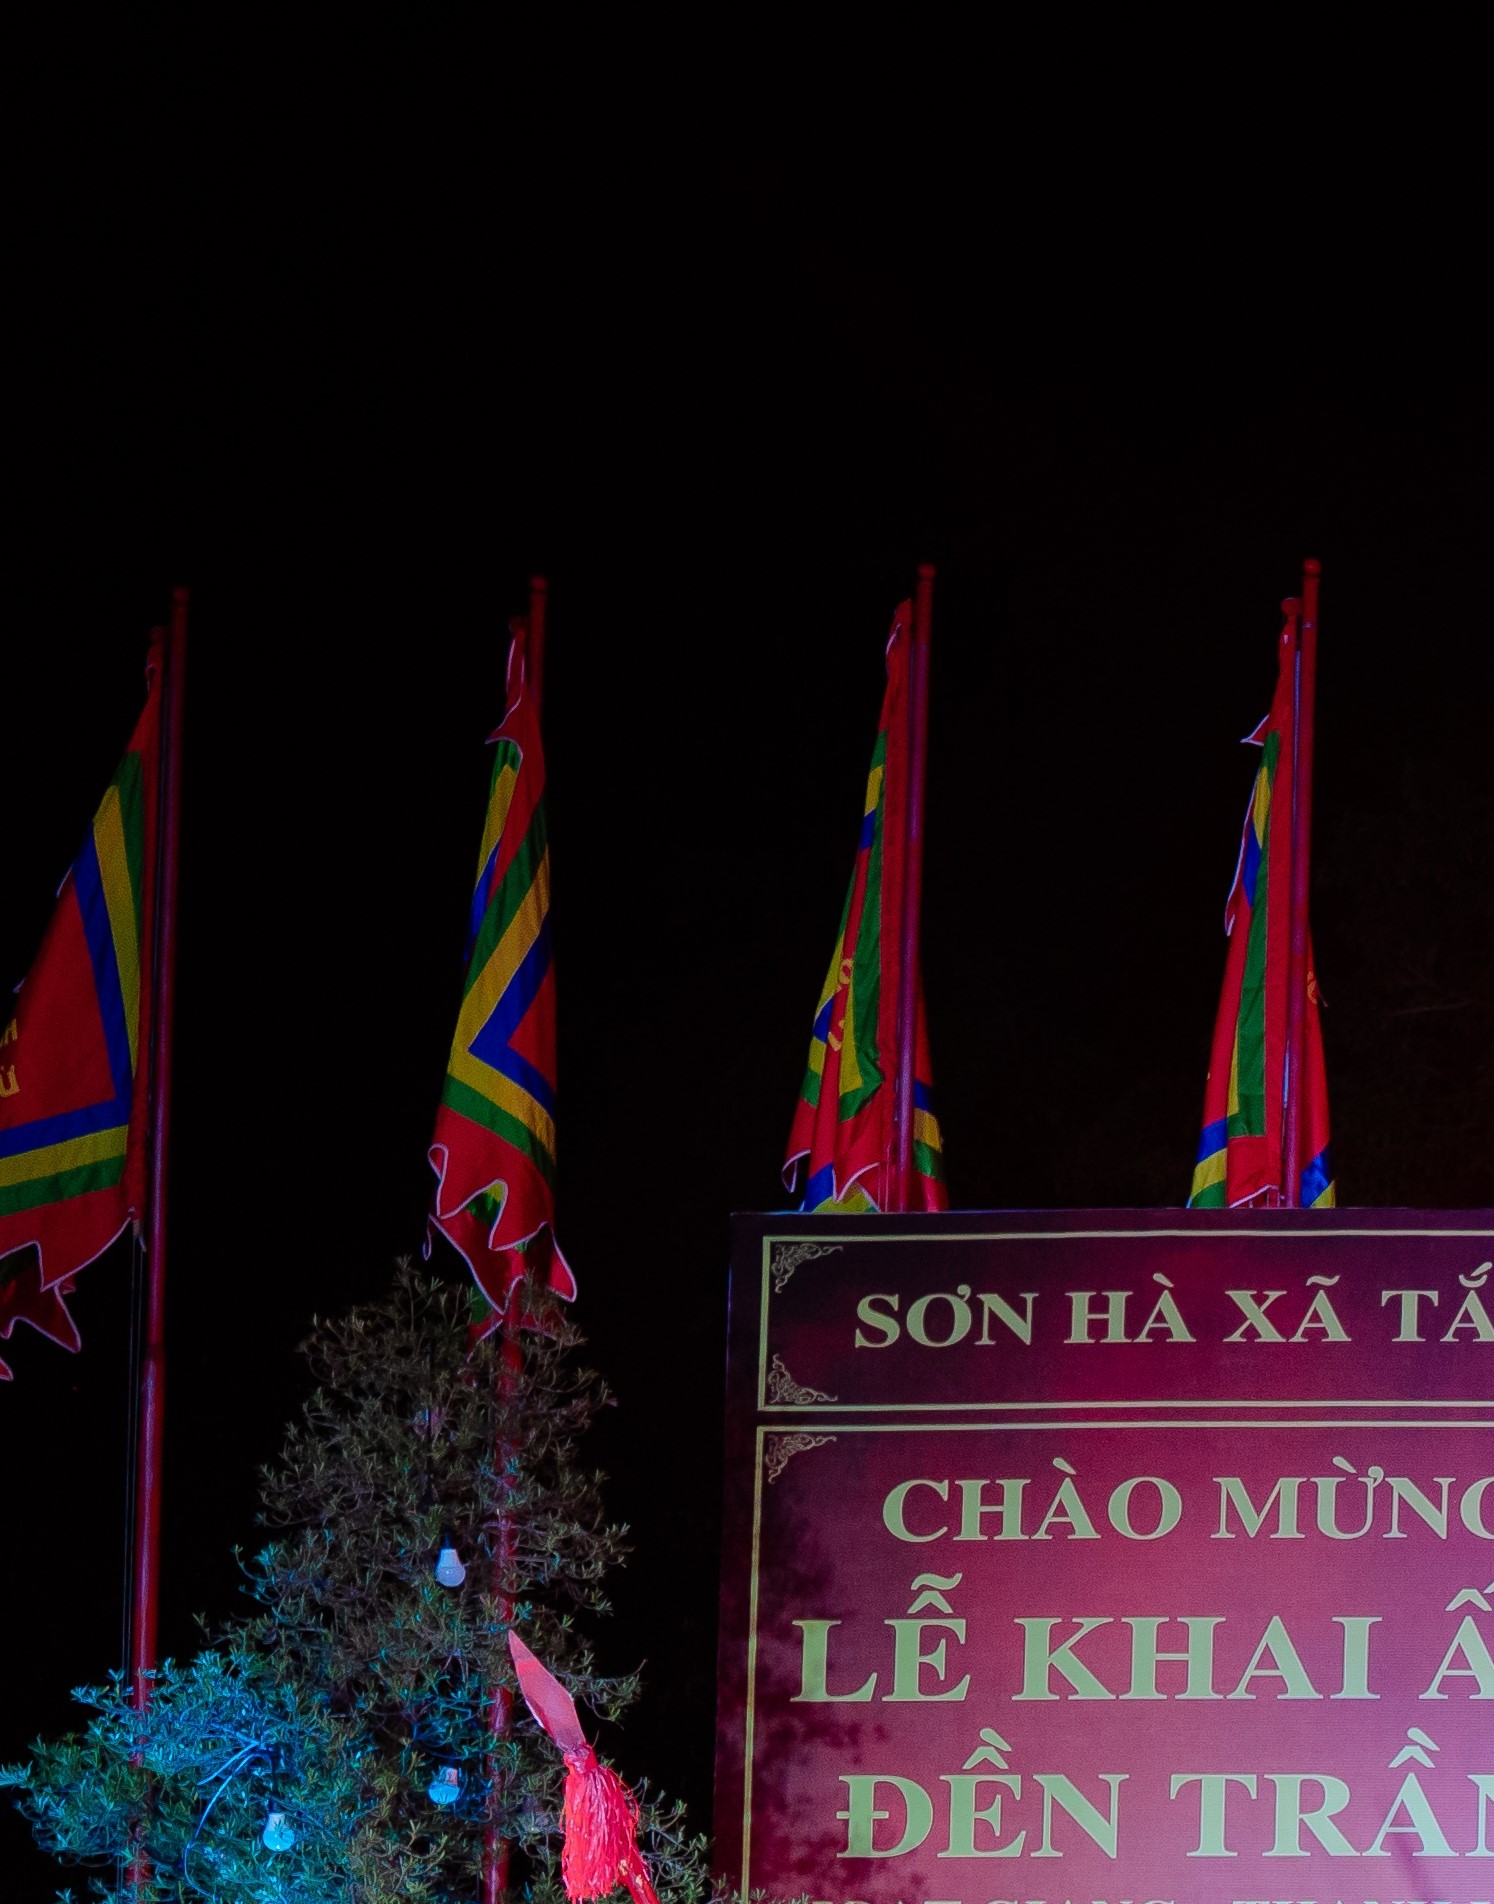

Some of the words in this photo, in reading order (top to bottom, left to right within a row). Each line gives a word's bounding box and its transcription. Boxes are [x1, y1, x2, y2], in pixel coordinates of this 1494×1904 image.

[854, 1284, 1039, 1348] SƠN
[1064, 1272, 1196, 1344] HÀ
[1223, 1275, 1352, 1343] XÃ
[882, 1457, 1183, 1543] CHÀO
[790, 1572, 971, 1703] LỄ
[1011, 1615, 1383, 1701] KHAI
[836, 1727, 1130, 1860] ĐỀN
